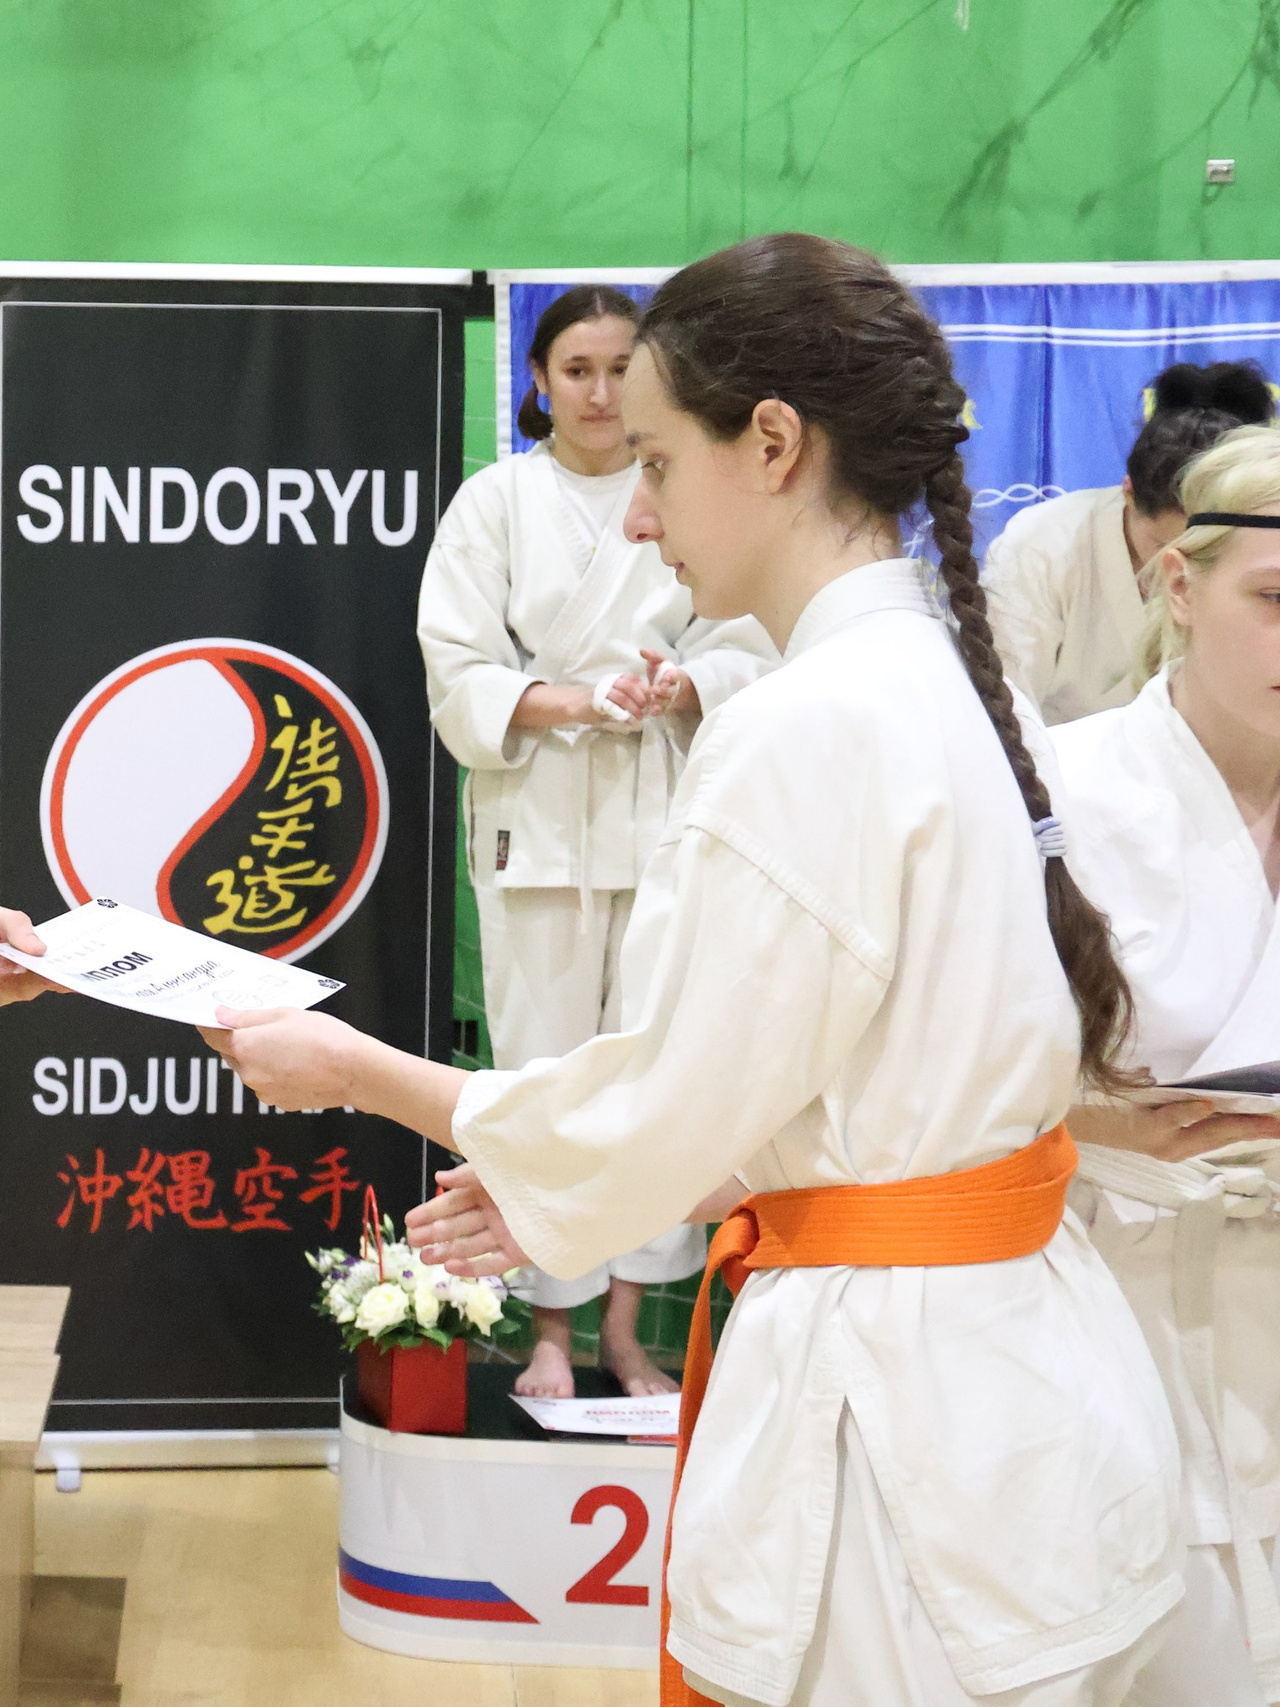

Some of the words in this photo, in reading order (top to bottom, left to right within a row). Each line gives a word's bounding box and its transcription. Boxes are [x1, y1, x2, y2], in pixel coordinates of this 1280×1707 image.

[17, 465, 419, 547] SINDORYU
[56, 1147, 361, 1234] 沖縄空手
[565, 1484, 650, 1607] 2
